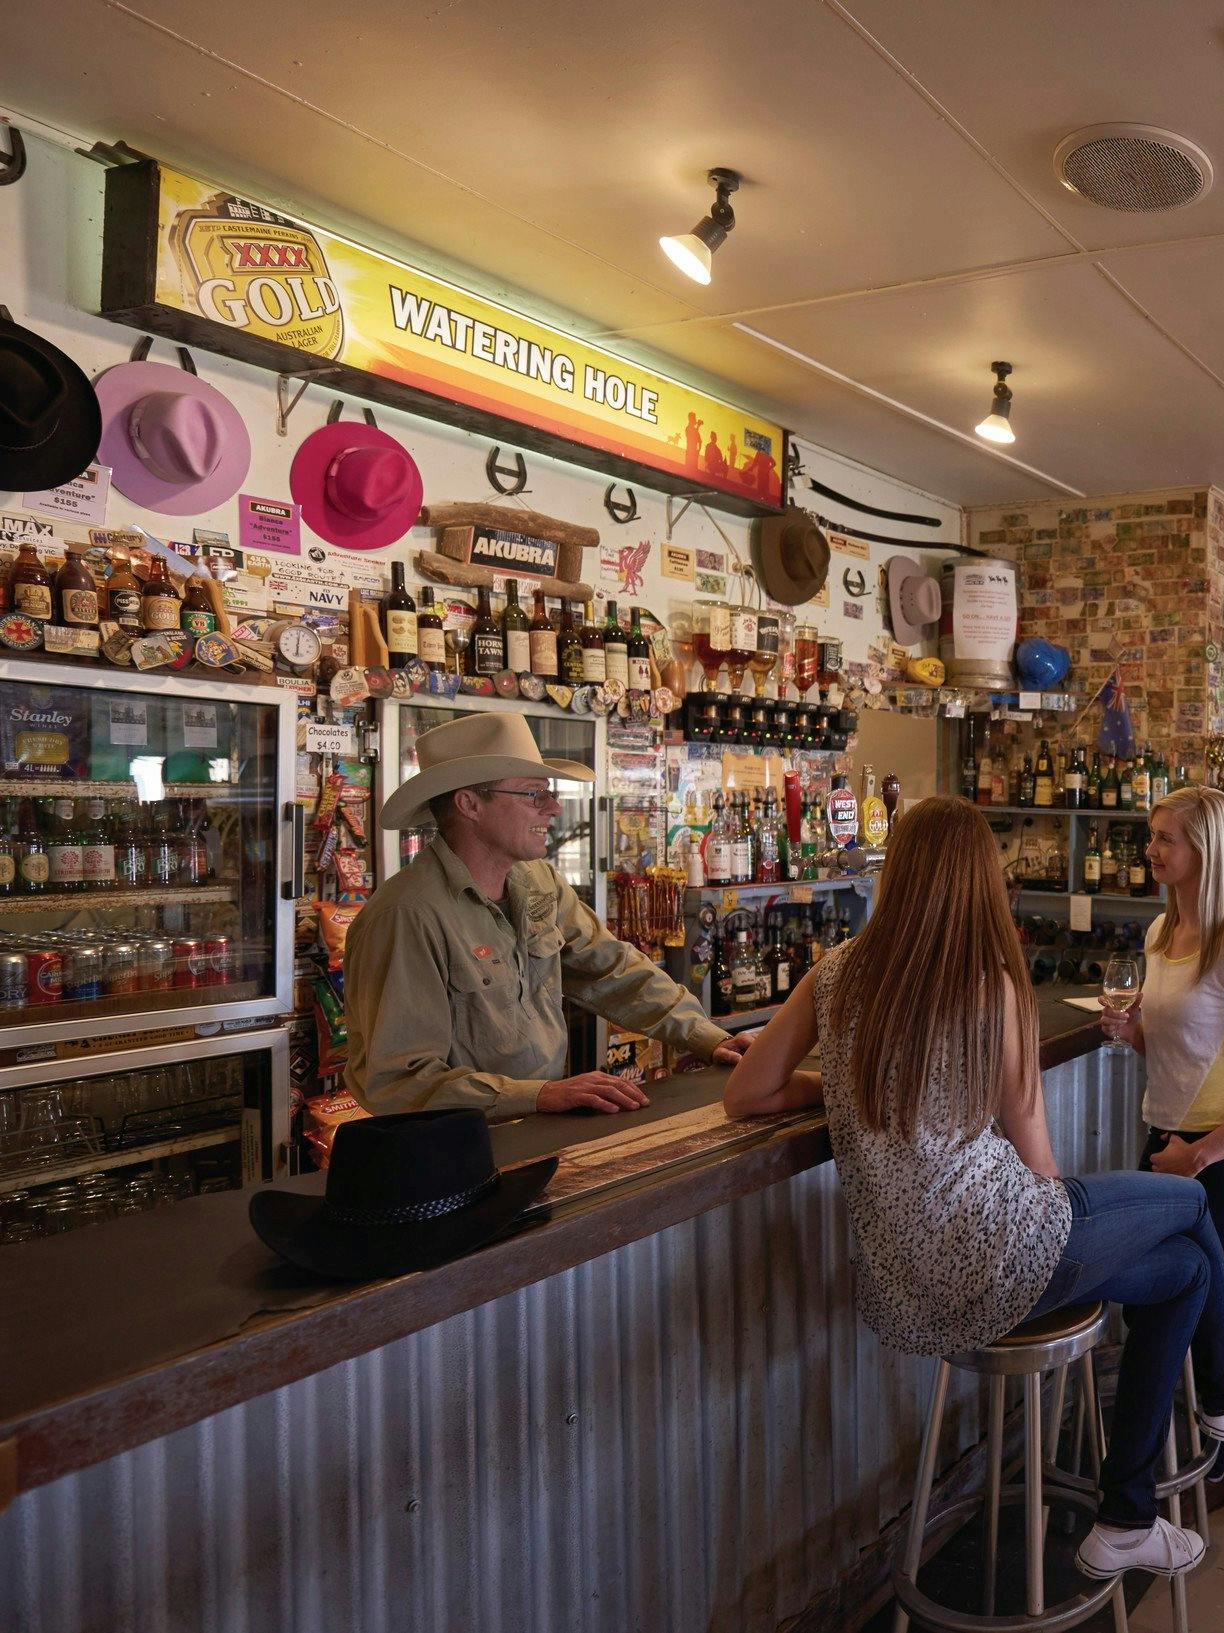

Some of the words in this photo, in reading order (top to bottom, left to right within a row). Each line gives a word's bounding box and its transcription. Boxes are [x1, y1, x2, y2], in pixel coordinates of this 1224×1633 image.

[223, 226, 272, 236] CASTLEMAINE
[231, 242, 311, 268] XXXX
[198, 277, 340, 328] GOLD
[276, 325, 323, 342] AUSTRALIAN
[292, 337, 318, 349] LAGER
[388, 284, 575, 393] WATERING
[584, 364, 659, 425] HOLE
[54, 496, 78, 508] $155
[255, 503, 286, 516] AKUBRA
[473, 536, 556, 566] AKUBRA
[275, 560, 312, 571] LOOKING
[279, 567, 302, 576] GOOD
[309, 591, 344, 605] NAVY
[479, 648, 503, 656] TAWN
[10, 708, 72, 727] Stanley
[308, 727, 349, 737] Chocolates
[317, 741, 341, 750] $4.00
[834, 800, 855, 809] WEST
[838, 811, 854, 820] END
[869, 819, 888, 832] GOLD
